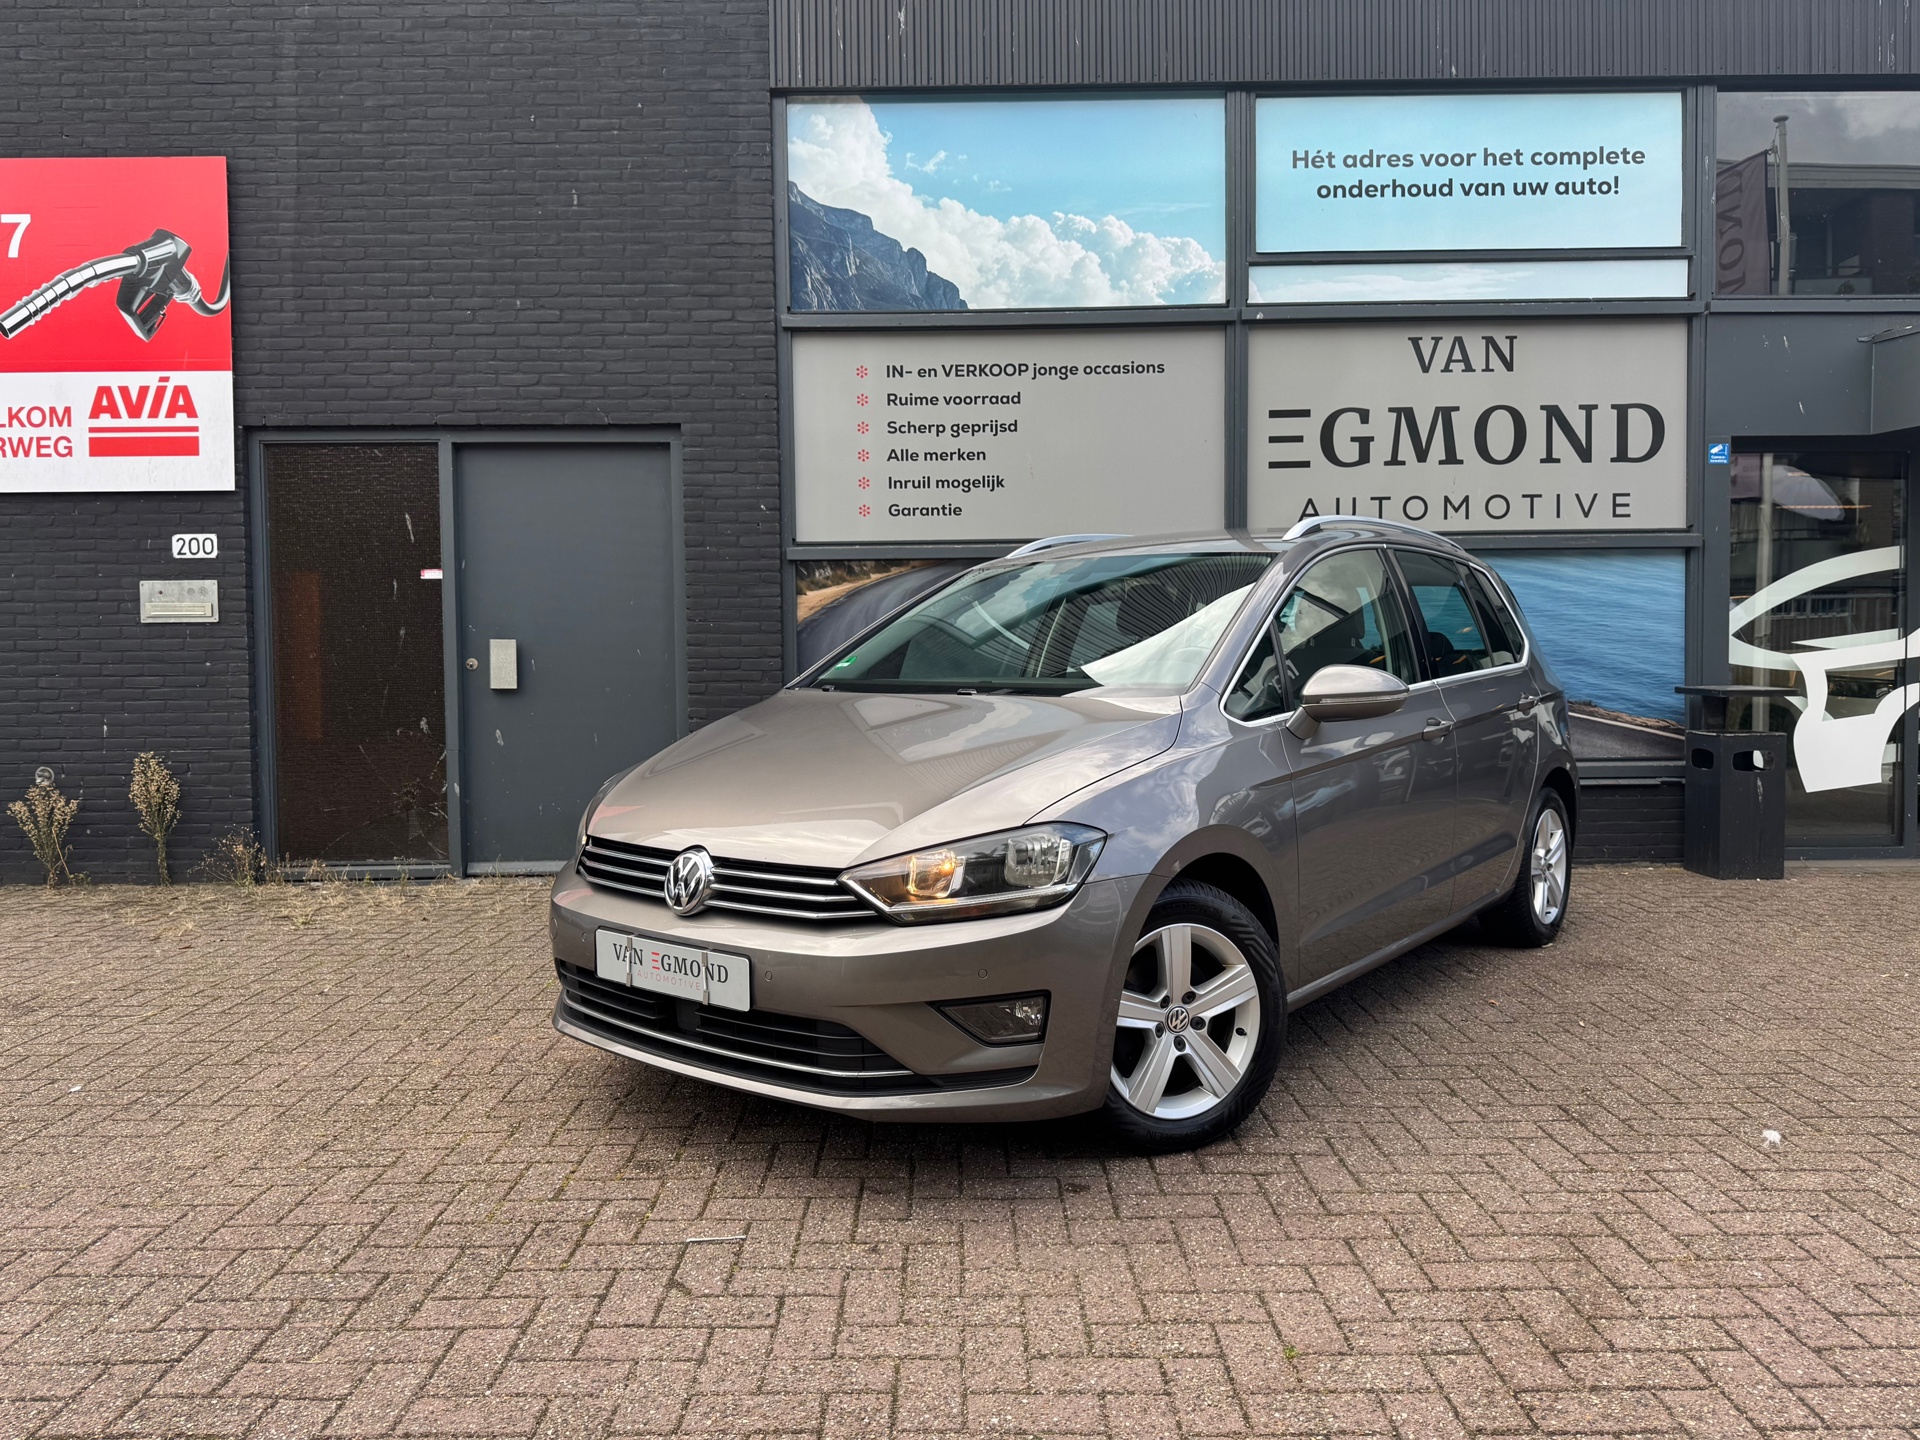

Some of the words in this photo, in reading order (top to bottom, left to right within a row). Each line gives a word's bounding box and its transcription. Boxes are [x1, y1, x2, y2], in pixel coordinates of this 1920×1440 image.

[1292, 149, 1336, 169] Hét
[1342, 149, 1414, 169] adres
[1419, 152, 1477, 168] voor
[1483, 147, 1524, 167] het
[1530, 145, 1646, 171] complete
[1316, 177, 1454, 199] onderhoud
[1459, 182, 1506, 197] van
[1512, 181, 1549, 197] uw
[1554, 175, 1619, 196] auto!
[1407, 335, 1518, 374] VAN
[886, 364, 913, 379] IN-
[917, 367, 938, 378] en
[941, 362, 1030, 378] VERKOOP
[1031, 362, 1079, 381] jonge
[1083, 360, 1165, 376] occasions
[886, 392, 940, 407] Ruime
[942, 391, 1021, 406] voorraad
[887, 420, 946, 438] Scherp
[950, 419, 1018, 439] geprijsd
[886, 448, 920, 462] Alle
[923, 447, 987, 462] merken
[888, 475, 931, 490] Inruil
[935, 474, 1005, 494] mogelijk
[888, 502, 963, 517] Garantie
[1299, 492, 1632, 521] AUTOMOTIVE
[176, 537, 214, 556] 200
[637, 970, 701, 990] AUTOMOTIVE
